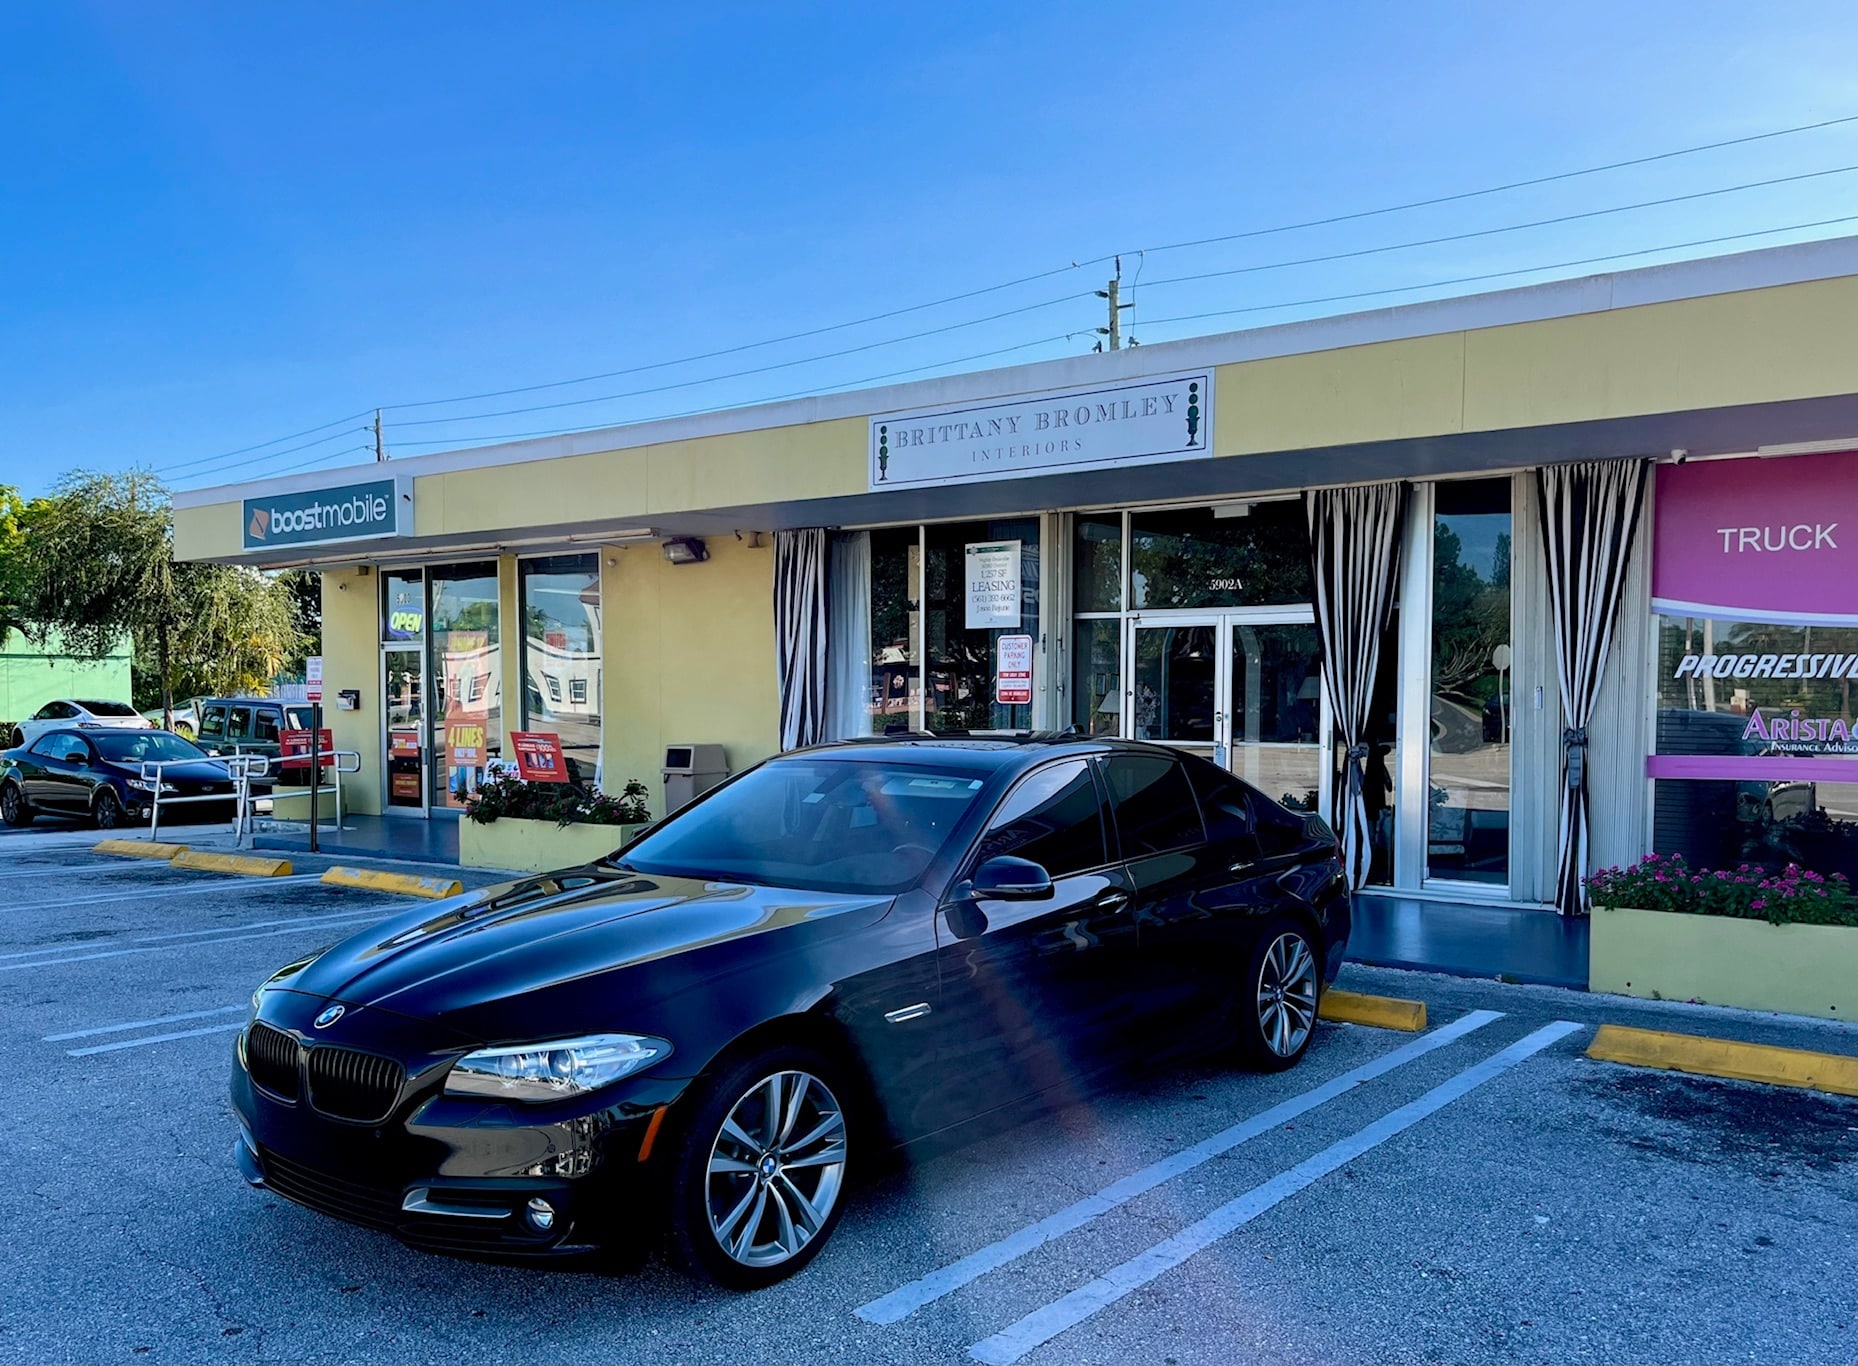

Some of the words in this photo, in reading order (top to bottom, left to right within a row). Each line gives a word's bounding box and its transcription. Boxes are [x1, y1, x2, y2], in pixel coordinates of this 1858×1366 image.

[894, 415, 1022, 449] BRITTANY
[1034, 393, 1180, 431] BROMLEY
[972, 438, 1083, 463] INTERIORS
[1716, 522, 1839, 554] TRUCK
[971, 580, 1016, 593] LEASING
[1208, 578, 1244, 591] 5902A
[390, 611, 423, 633] OPEN
[1001, 642, 1029, 650] CUSTOMER
[1003, 651, 1026, 660] PARKING
[1007, 660, 1021, 669] ONLY
[455, 726, 484, 748] LINES
